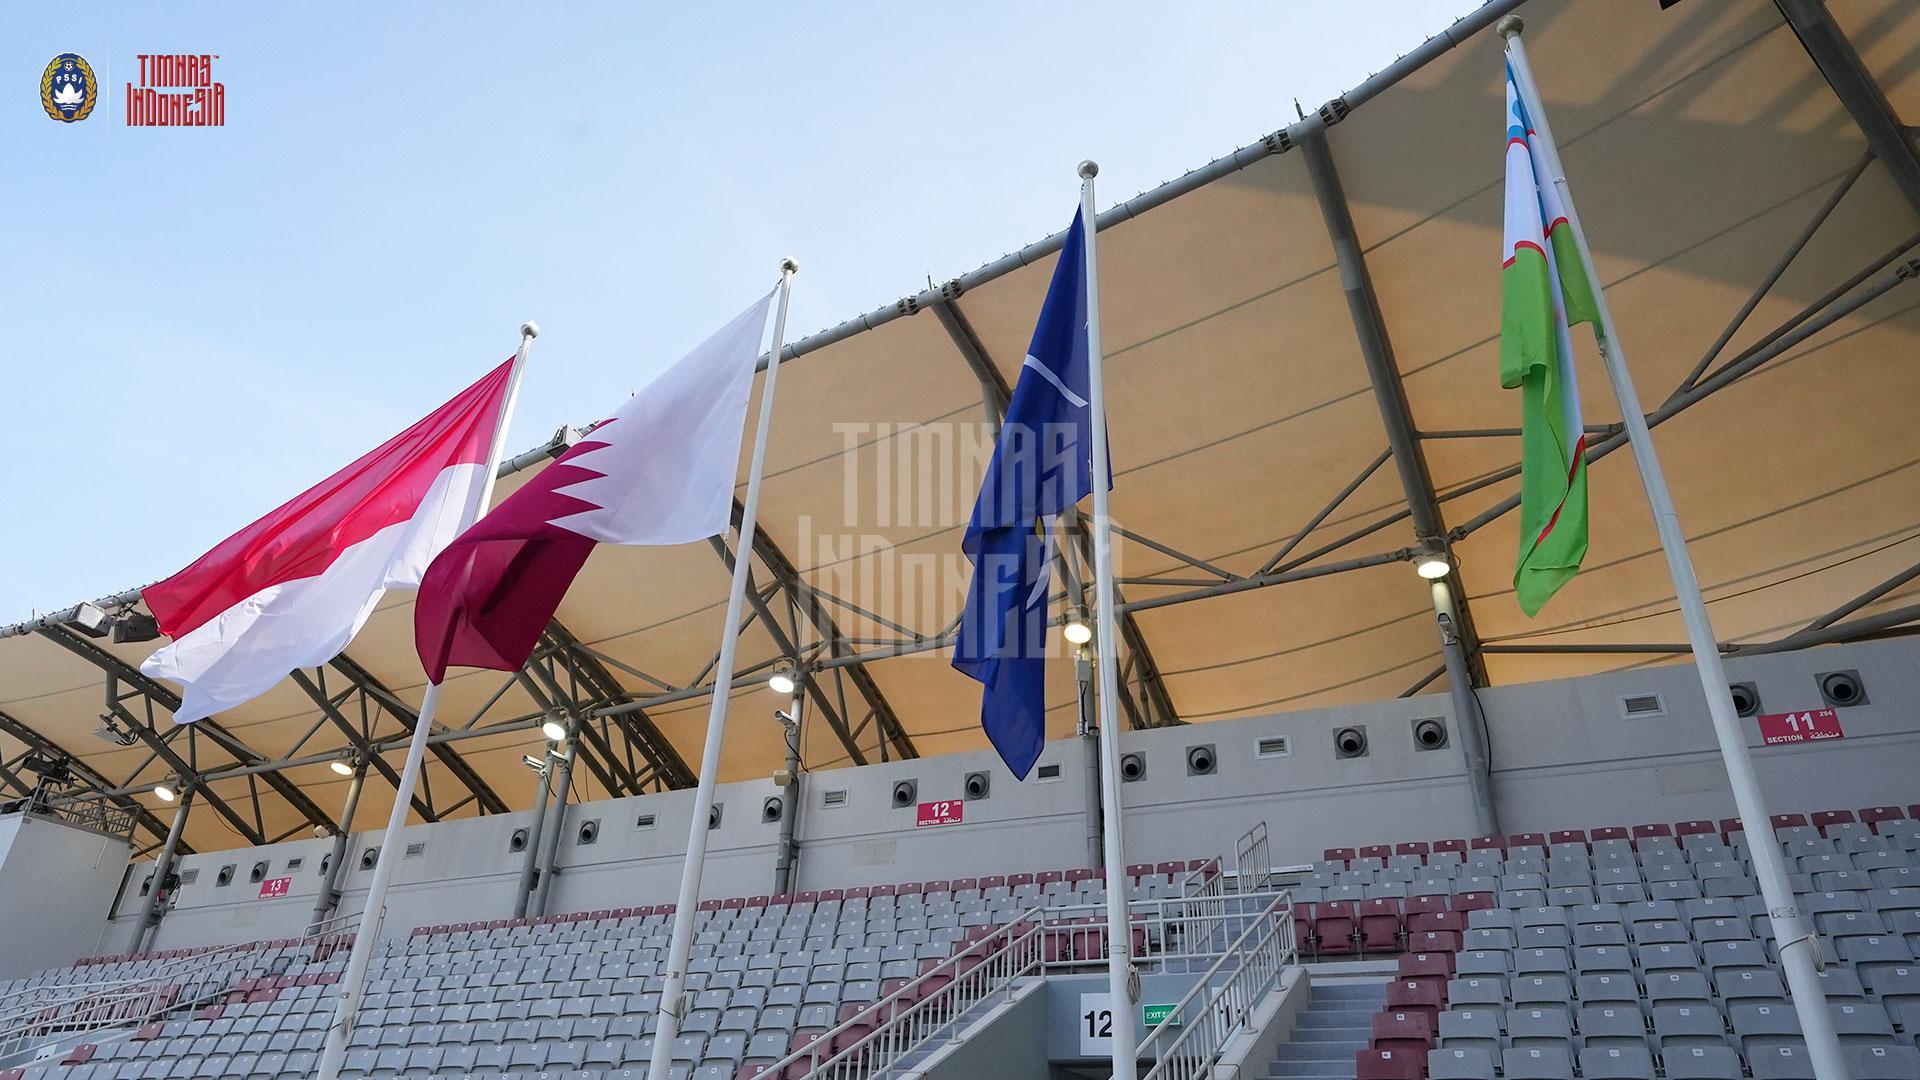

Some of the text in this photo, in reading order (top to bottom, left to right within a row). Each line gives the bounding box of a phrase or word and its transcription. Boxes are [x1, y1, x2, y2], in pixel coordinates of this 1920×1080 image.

[1785, 712, 1815, 732] 11
[1767, 735, 1803, 744] SECTION
[932, 802, 949, 817] 12
[271, 879, 282, 891] 13
[1146, 1011, 1161, 1019] EXIT
[1084, 1010, 1112, 1038] 12
